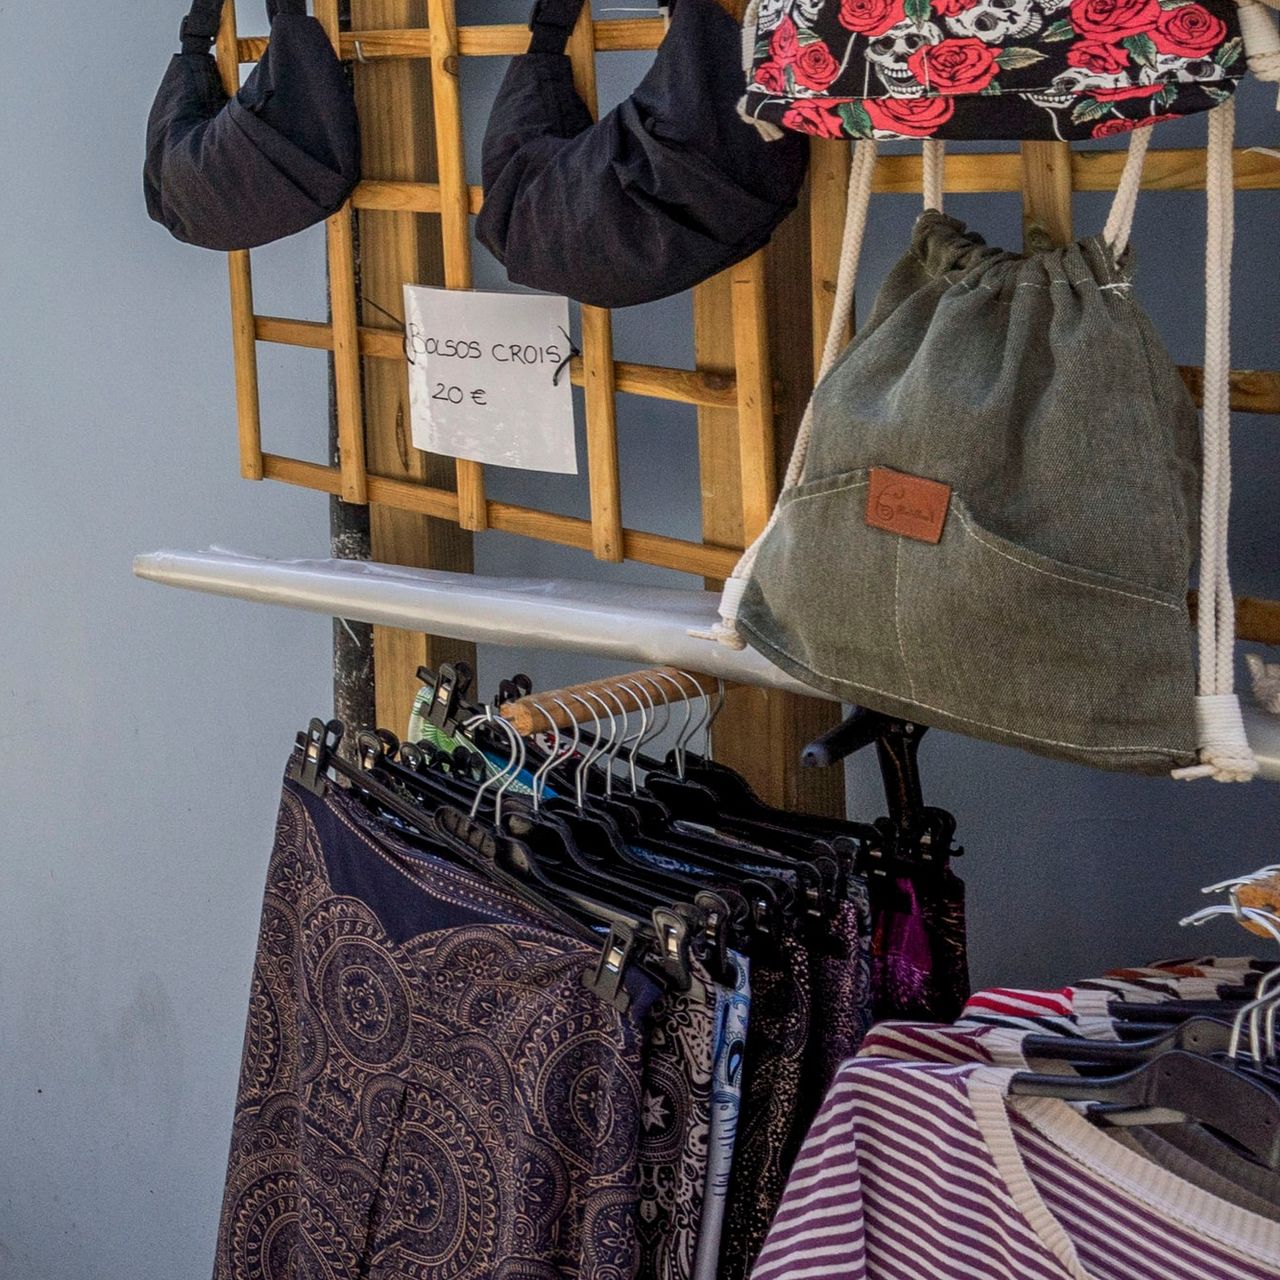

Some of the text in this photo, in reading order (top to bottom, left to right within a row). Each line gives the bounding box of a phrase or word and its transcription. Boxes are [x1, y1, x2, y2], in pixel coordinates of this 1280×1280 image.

[408, 323, 562, 365] BOLSOS CROIS
[431, 382, 487, 405] 20 €
